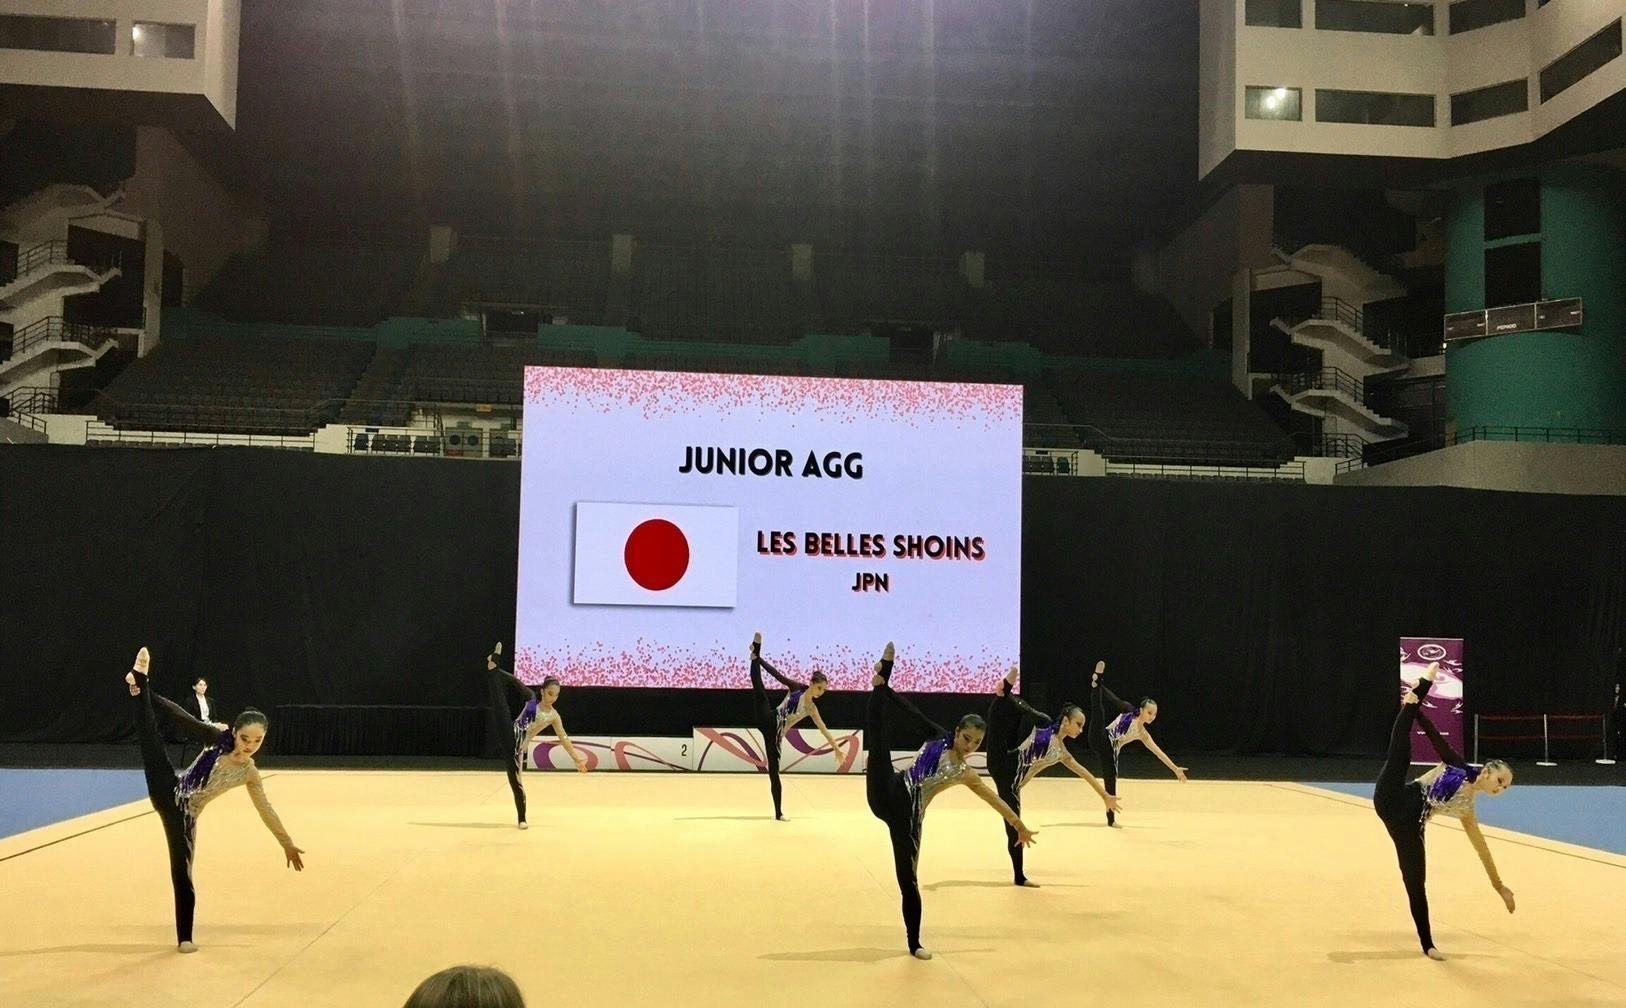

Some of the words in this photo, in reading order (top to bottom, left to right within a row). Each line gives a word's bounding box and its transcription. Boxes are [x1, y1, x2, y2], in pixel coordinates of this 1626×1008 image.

[678, 446, 793, 477] JUNIOR
[801, 449, 863, 480] AGG
[756, 530, 798, 556] LES
[804, 531, 886, 558] BELLES
[892, 534, 986, 562] SHOINS
[851, 572, 890, 594] JPN
[681, 743, 688, 756] 2
